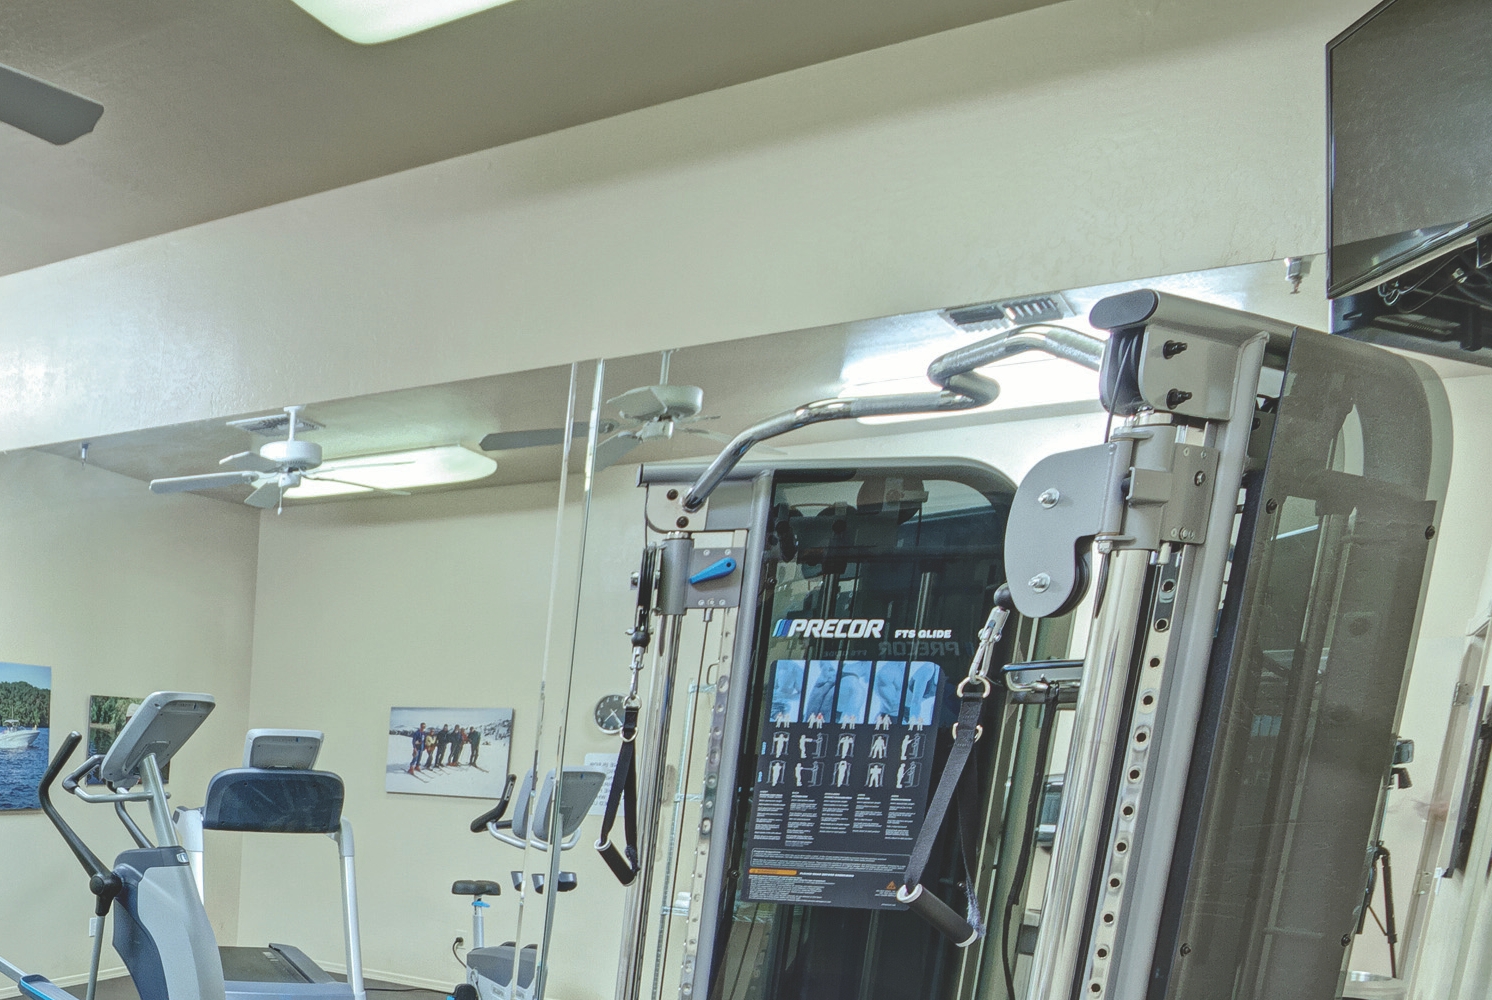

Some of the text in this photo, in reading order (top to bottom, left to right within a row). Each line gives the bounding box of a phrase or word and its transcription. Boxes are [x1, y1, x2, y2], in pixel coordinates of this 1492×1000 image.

[787, 618, 952, 639] PRECOR FTS GLIDE
